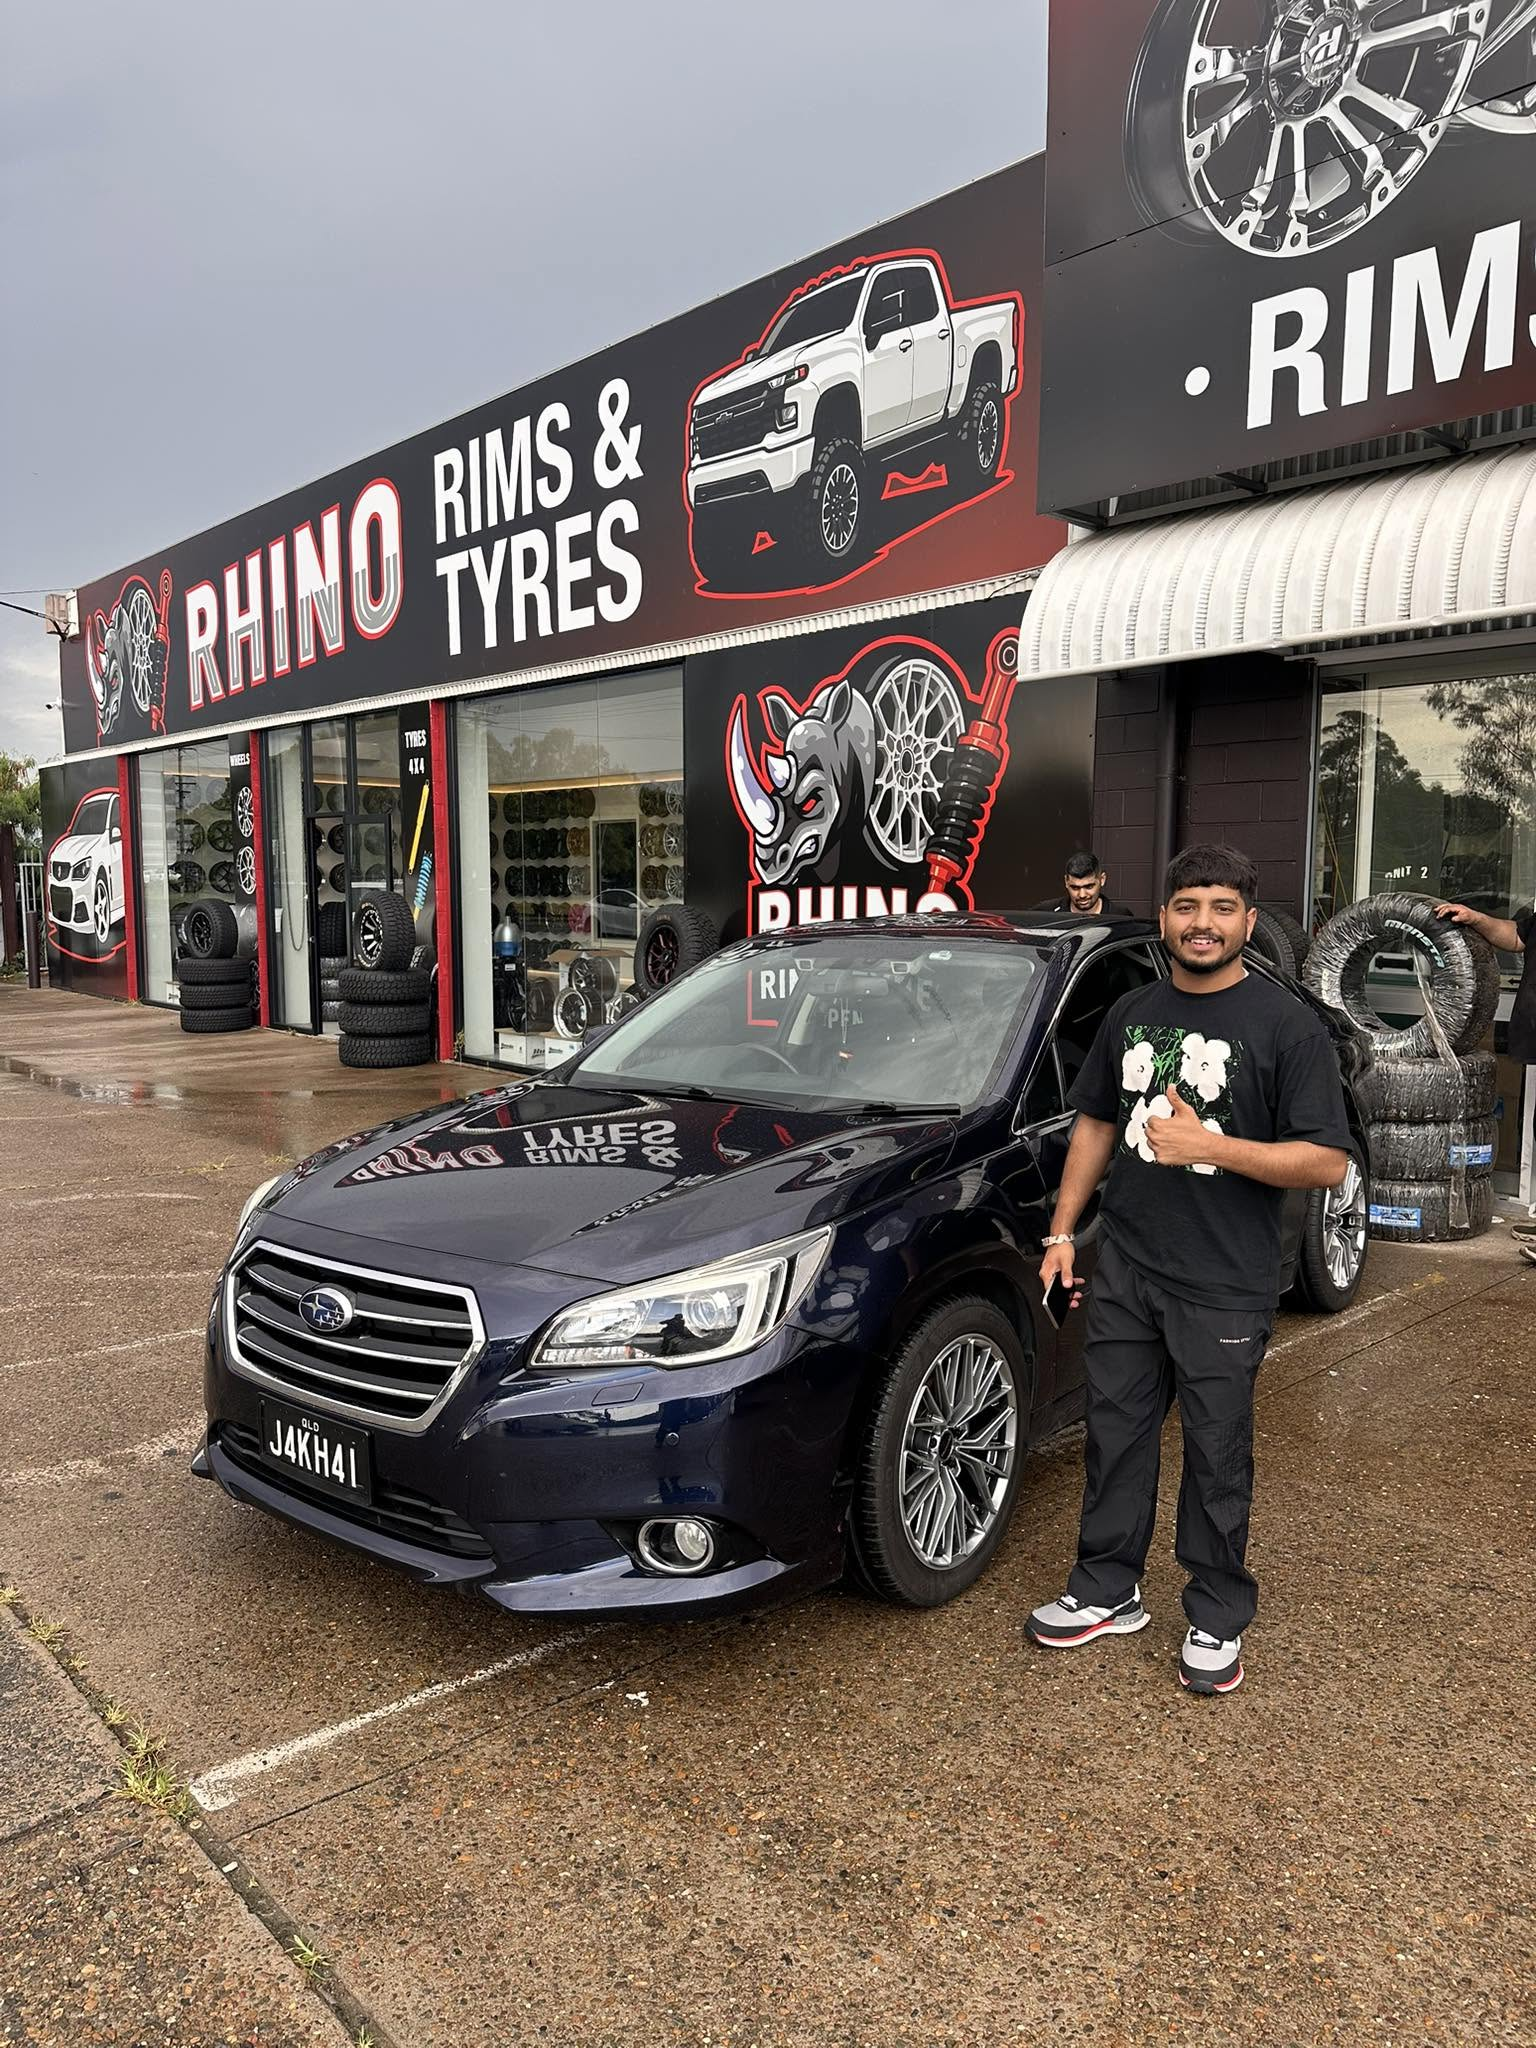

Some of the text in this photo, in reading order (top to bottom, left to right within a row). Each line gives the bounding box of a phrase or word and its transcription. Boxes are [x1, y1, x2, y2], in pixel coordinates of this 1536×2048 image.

[1247, 220, 1536, 430] RIM
[433, 377, 644, 545] RIMS &
[435, 499, 643, 657] TYRES
[184, 477, 403, 712] RHINO
[404, 729, 427, 749] TYRES
[229, 752, 250, 767] WHEELS
[408, 756, 425, 776] 4X4
[1420, 866, 1428, 879] 2
[301, 1418, 320, 1433] QLD
